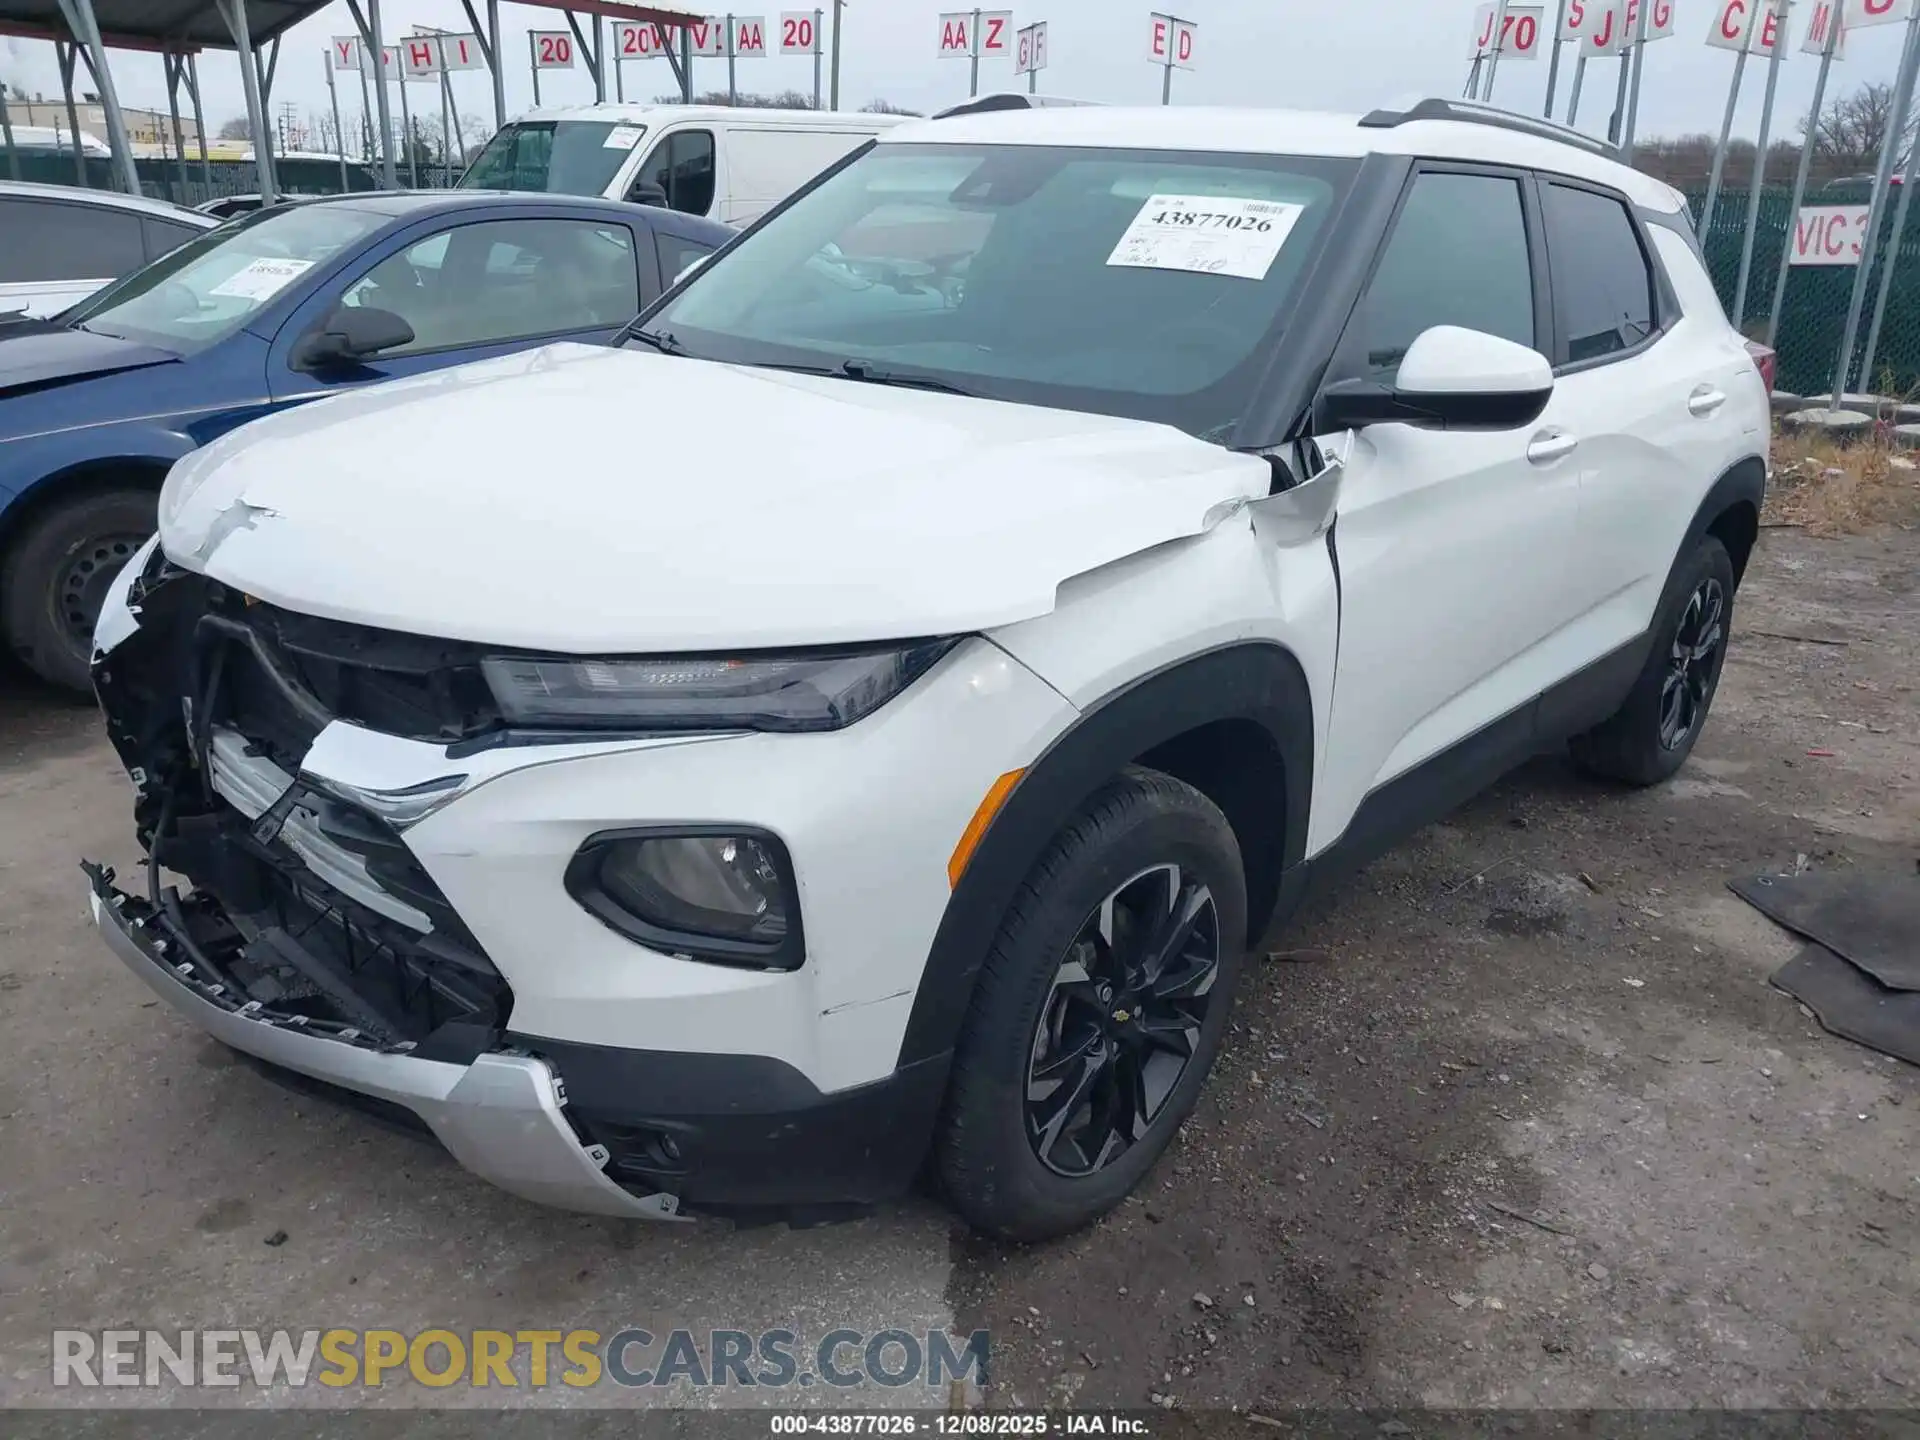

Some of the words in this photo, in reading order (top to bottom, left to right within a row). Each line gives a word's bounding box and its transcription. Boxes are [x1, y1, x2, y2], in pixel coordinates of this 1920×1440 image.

[783, 19, 812, 47] 20
[985, 19, 1004, 49] Z
[1478, 12, 1495, 47] J
[1593, 10, 1612, 47] J
[1721, 0, 1745, 39] C
[540, 37, 570, 63] 20
[623, 28, 648, 53] 20
[739, 23, 763, 50] AA
[942, 21, 968, 50] AA
[1036, 32, 1044, 61] F
[1153, 23, 1165, 55] E
[1179, 30, 1192, 60] D
[337, 41, 350, 64] Y
[410, 42, 432, 67] H
[458, 39, 468, 64] I
[1019, 37, 1027, 66] G
[1152, 211, 1274, 232] 43877026
[1796, 214, 1847, 256] VIC
